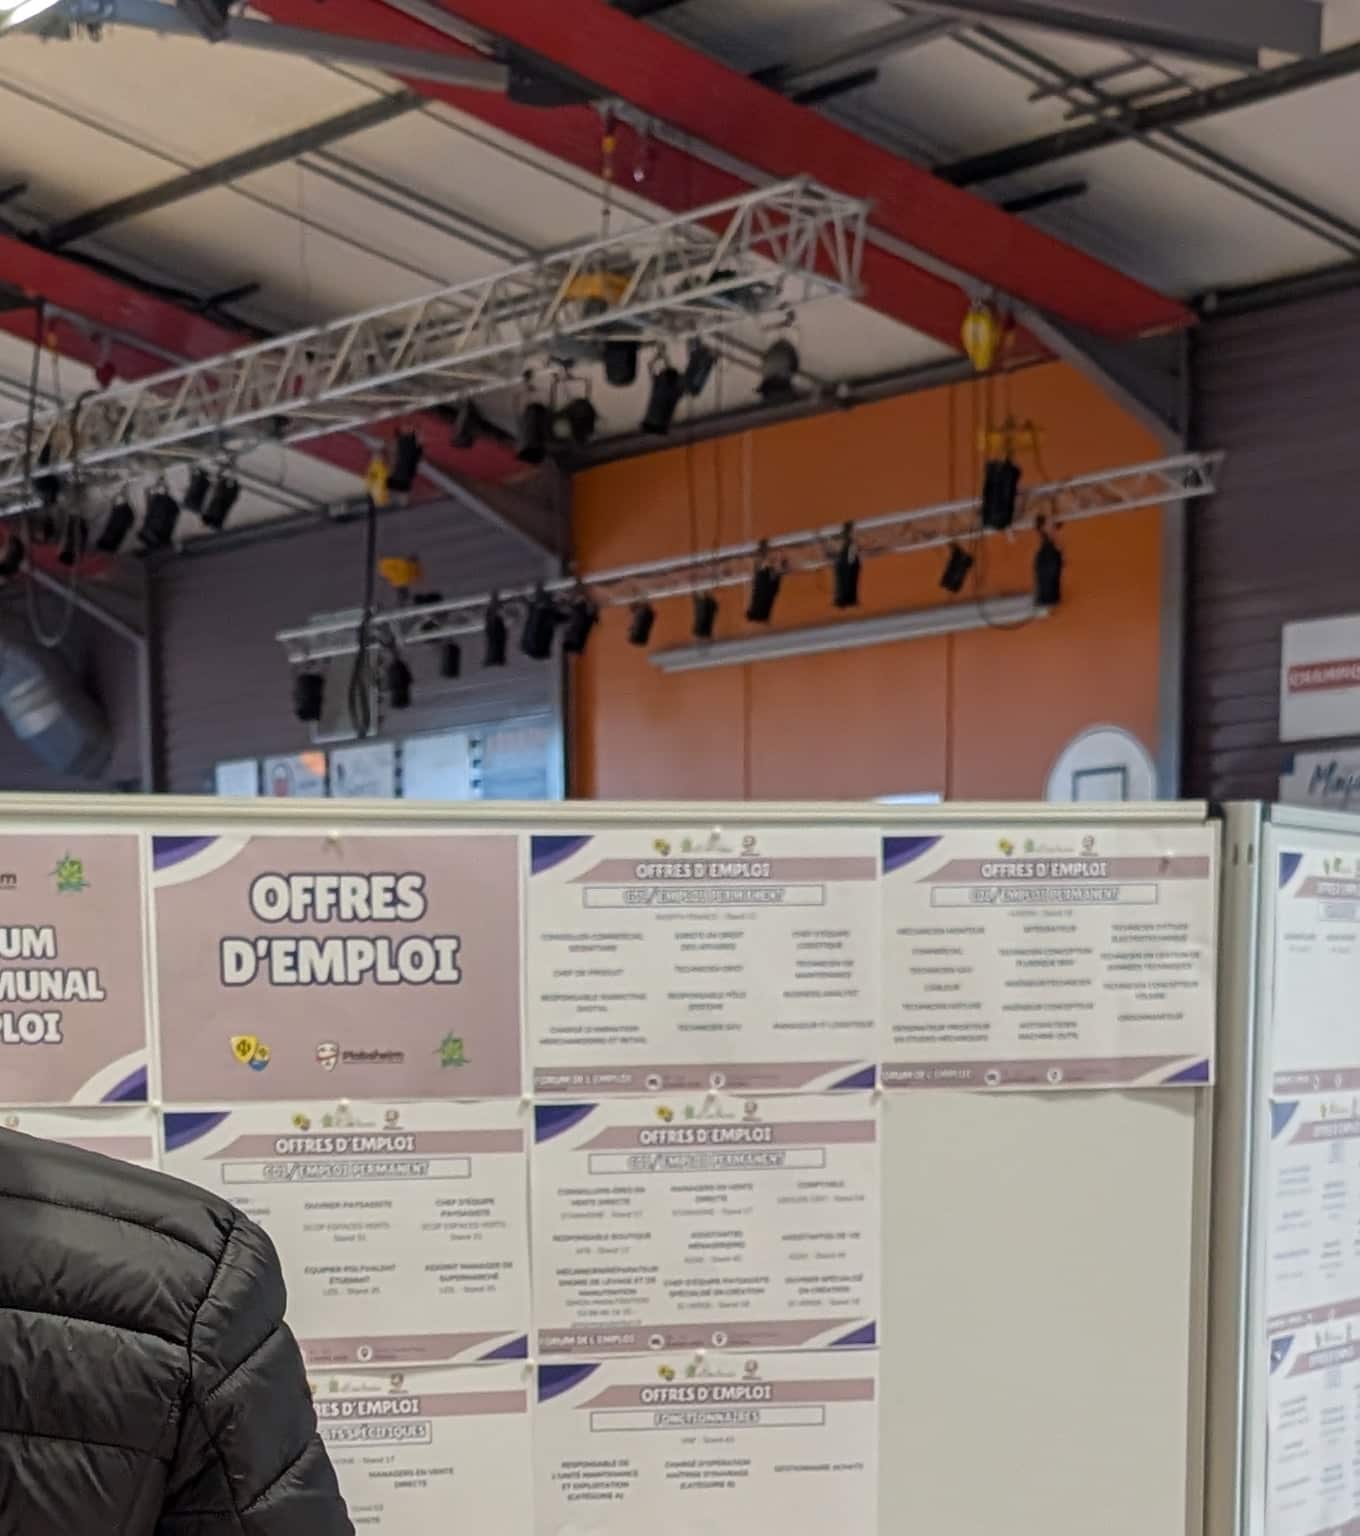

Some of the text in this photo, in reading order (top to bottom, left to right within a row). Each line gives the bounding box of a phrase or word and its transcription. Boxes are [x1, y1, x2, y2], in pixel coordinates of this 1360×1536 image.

[636, 862, 771, 880] OFFRES D'EMPLOI
[981, 861, 1108, 879] OFFRES D'EMPLOI
[250, 872, 427, 923] OFFRES
[220, 936, 461, 986] D'EMPLOI
[640, 1126, 772, 1144] OFFRES D'EMPLOI
[275, 1135, 415, 1155] OFFRES D'EMPLOI
[351, 1161, 429, 1178] PERMANENT
[641, 1385, 772, 1403] OFFRES D'EMPLOI
[313, 1399, 419, 1418] RES D'EMPLOI
[654, 1410, 760, 1426] FONCTIONNAIRES
